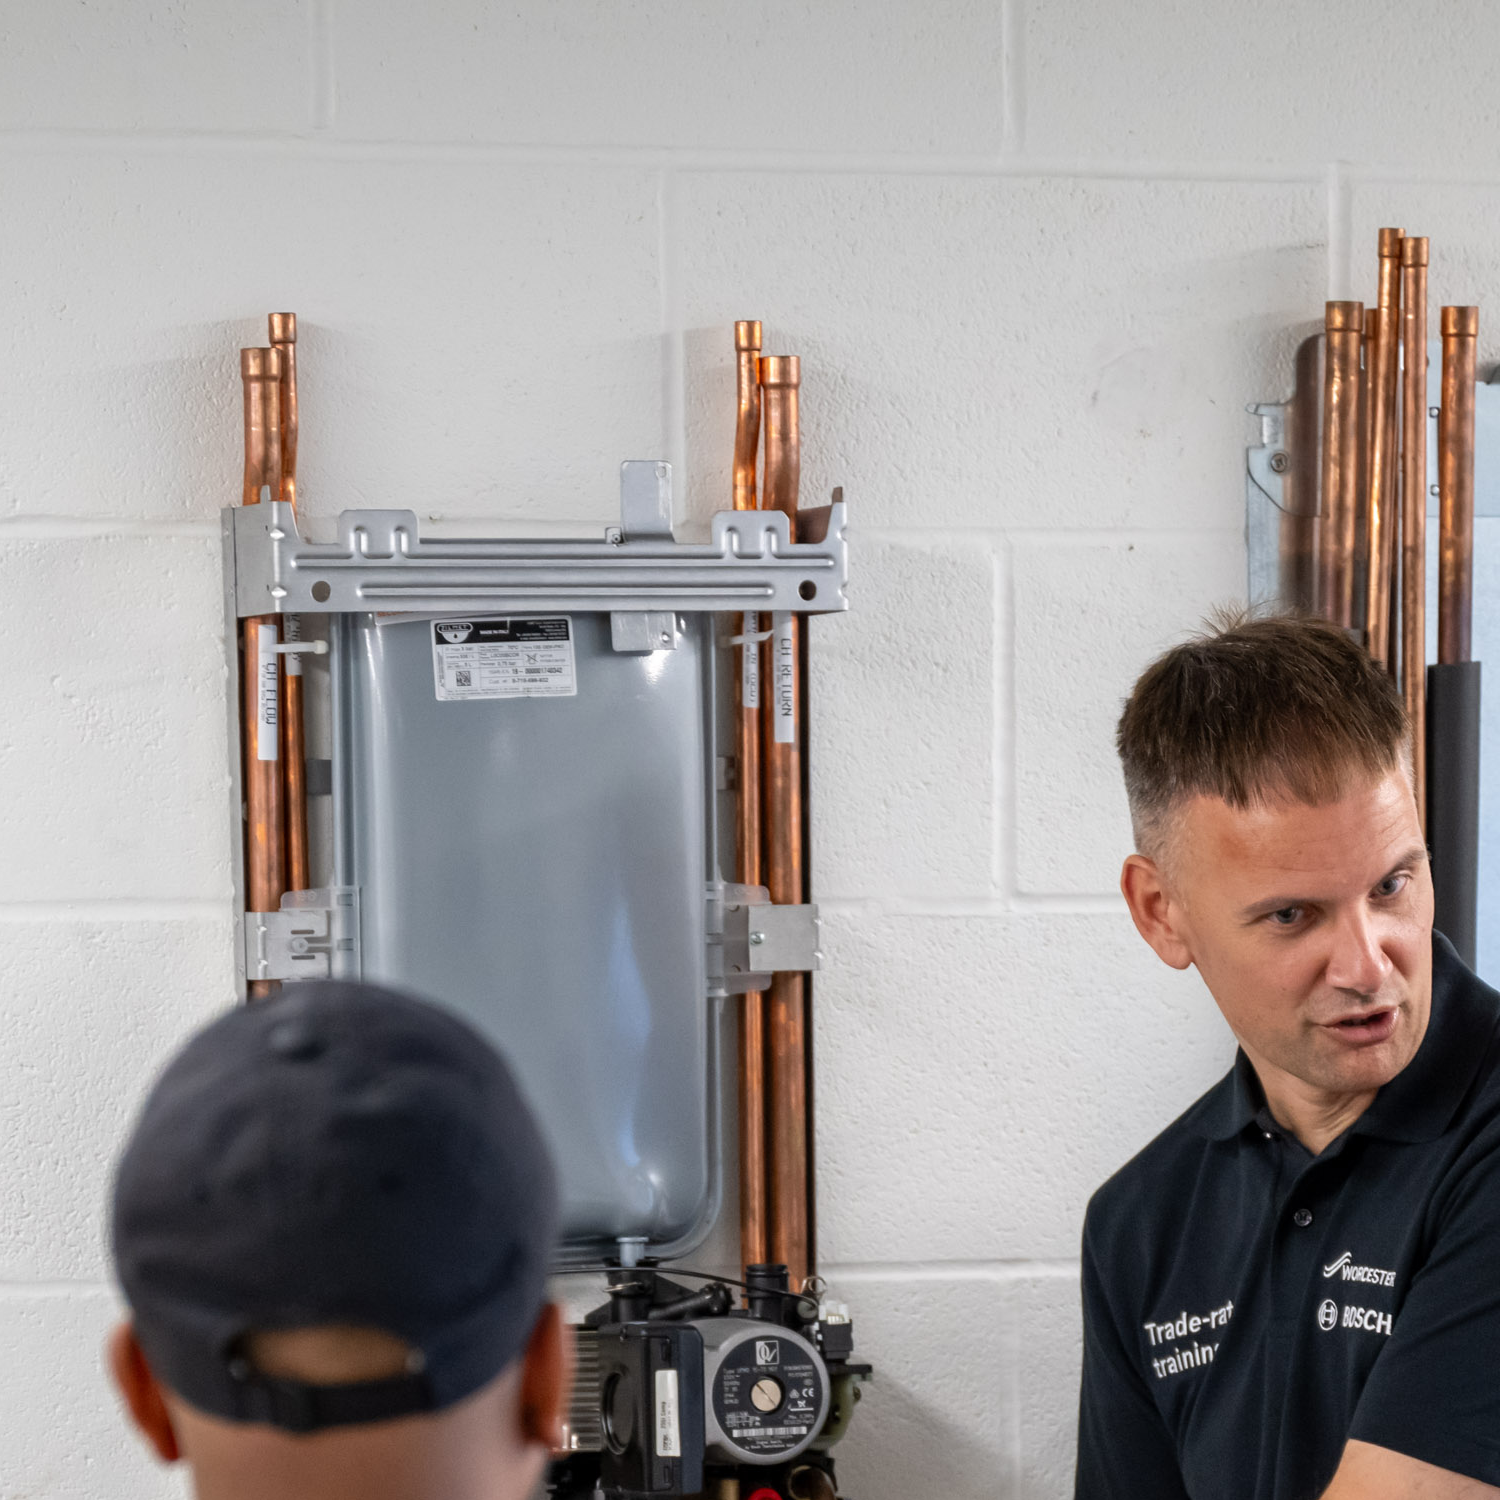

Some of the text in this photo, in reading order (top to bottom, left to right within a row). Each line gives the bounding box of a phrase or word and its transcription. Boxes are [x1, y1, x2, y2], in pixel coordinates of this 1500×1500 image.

[266, 689, 277, 725] FLOW
[781, 664, 793, 717] RETURN
[1342, 1265, 1396, 1287] WORCESTER
[1342, 1306, 1393, 1336] BOSCH
[1153, 1341, 1220, 1378] trainin
